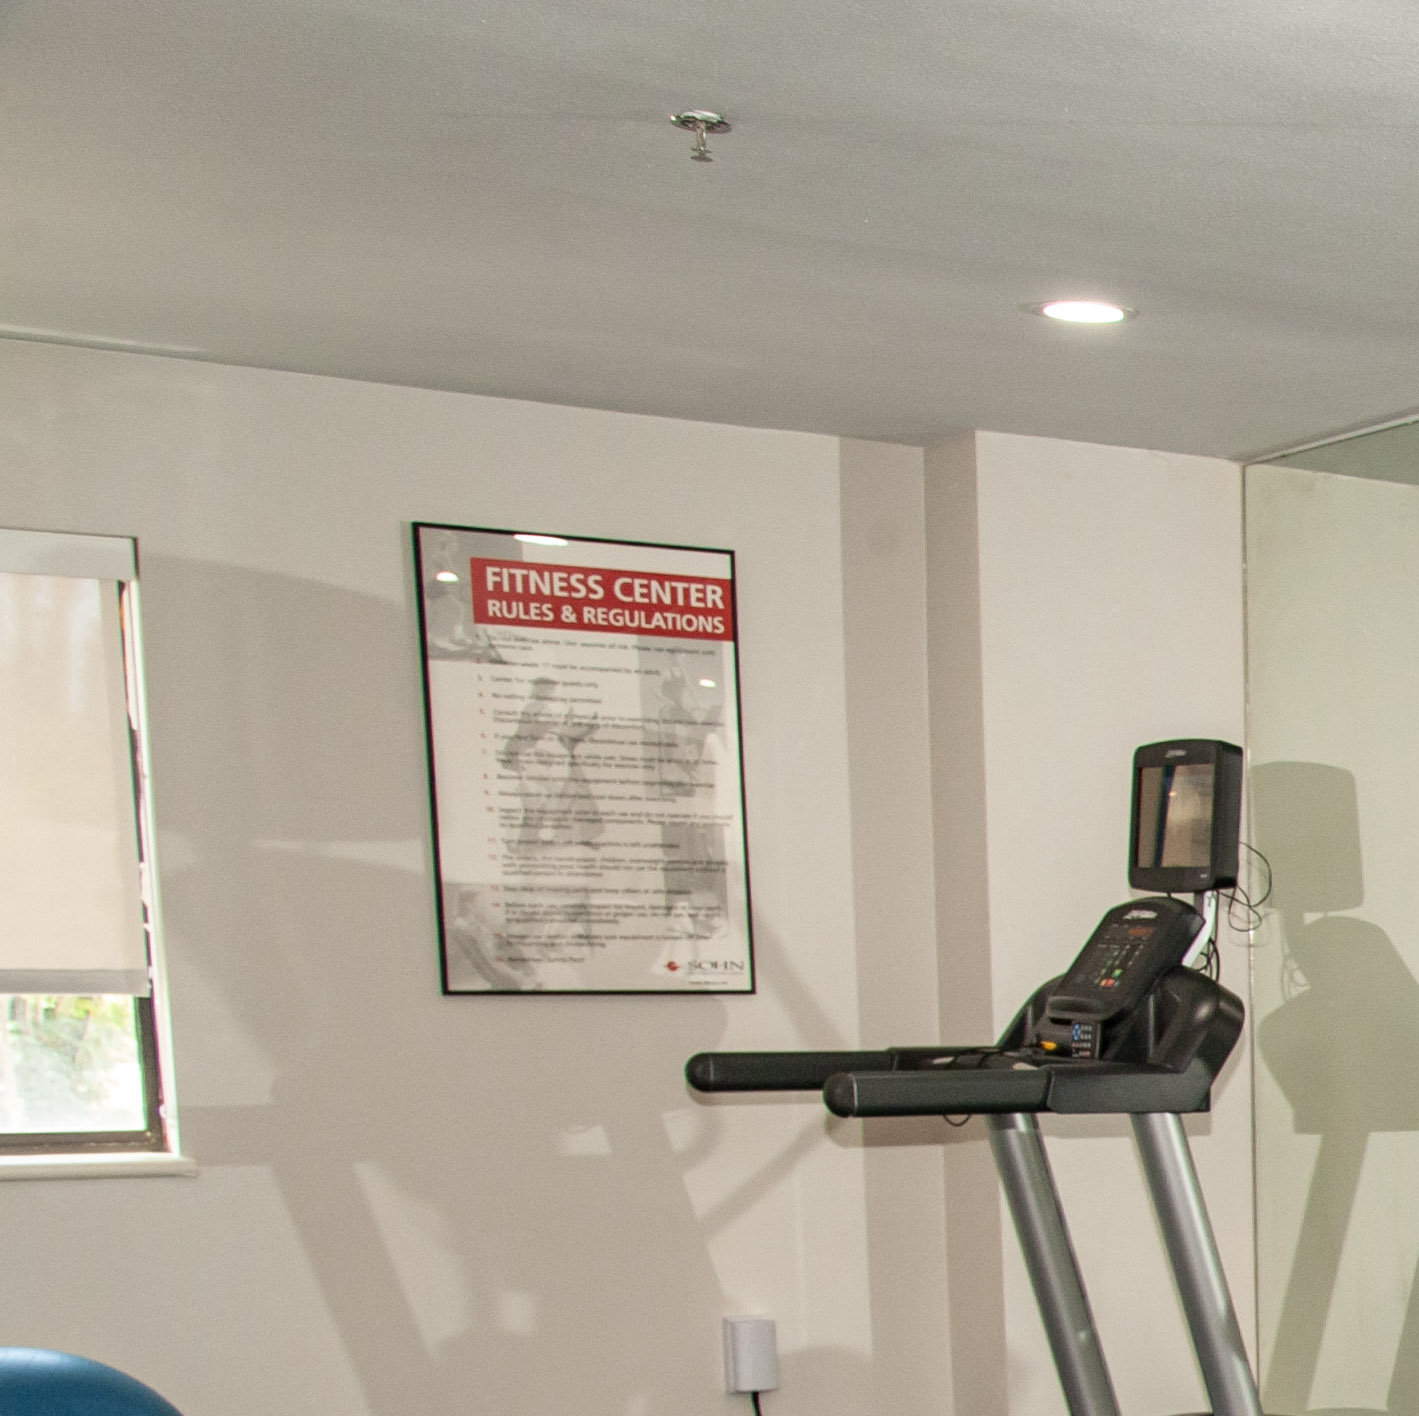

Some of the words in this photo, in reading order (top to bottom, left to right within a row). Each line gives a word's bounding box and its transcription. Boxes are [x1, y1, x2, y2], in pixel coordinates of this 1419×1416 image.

[486, 566, 604, 600] FITNESS
[613, 577, 725, 609] CENTER
[488, 599, 554, 622] RULES
[561, 605, 577, 624] &
[583, 607, 725, 634] REGULATIONS
